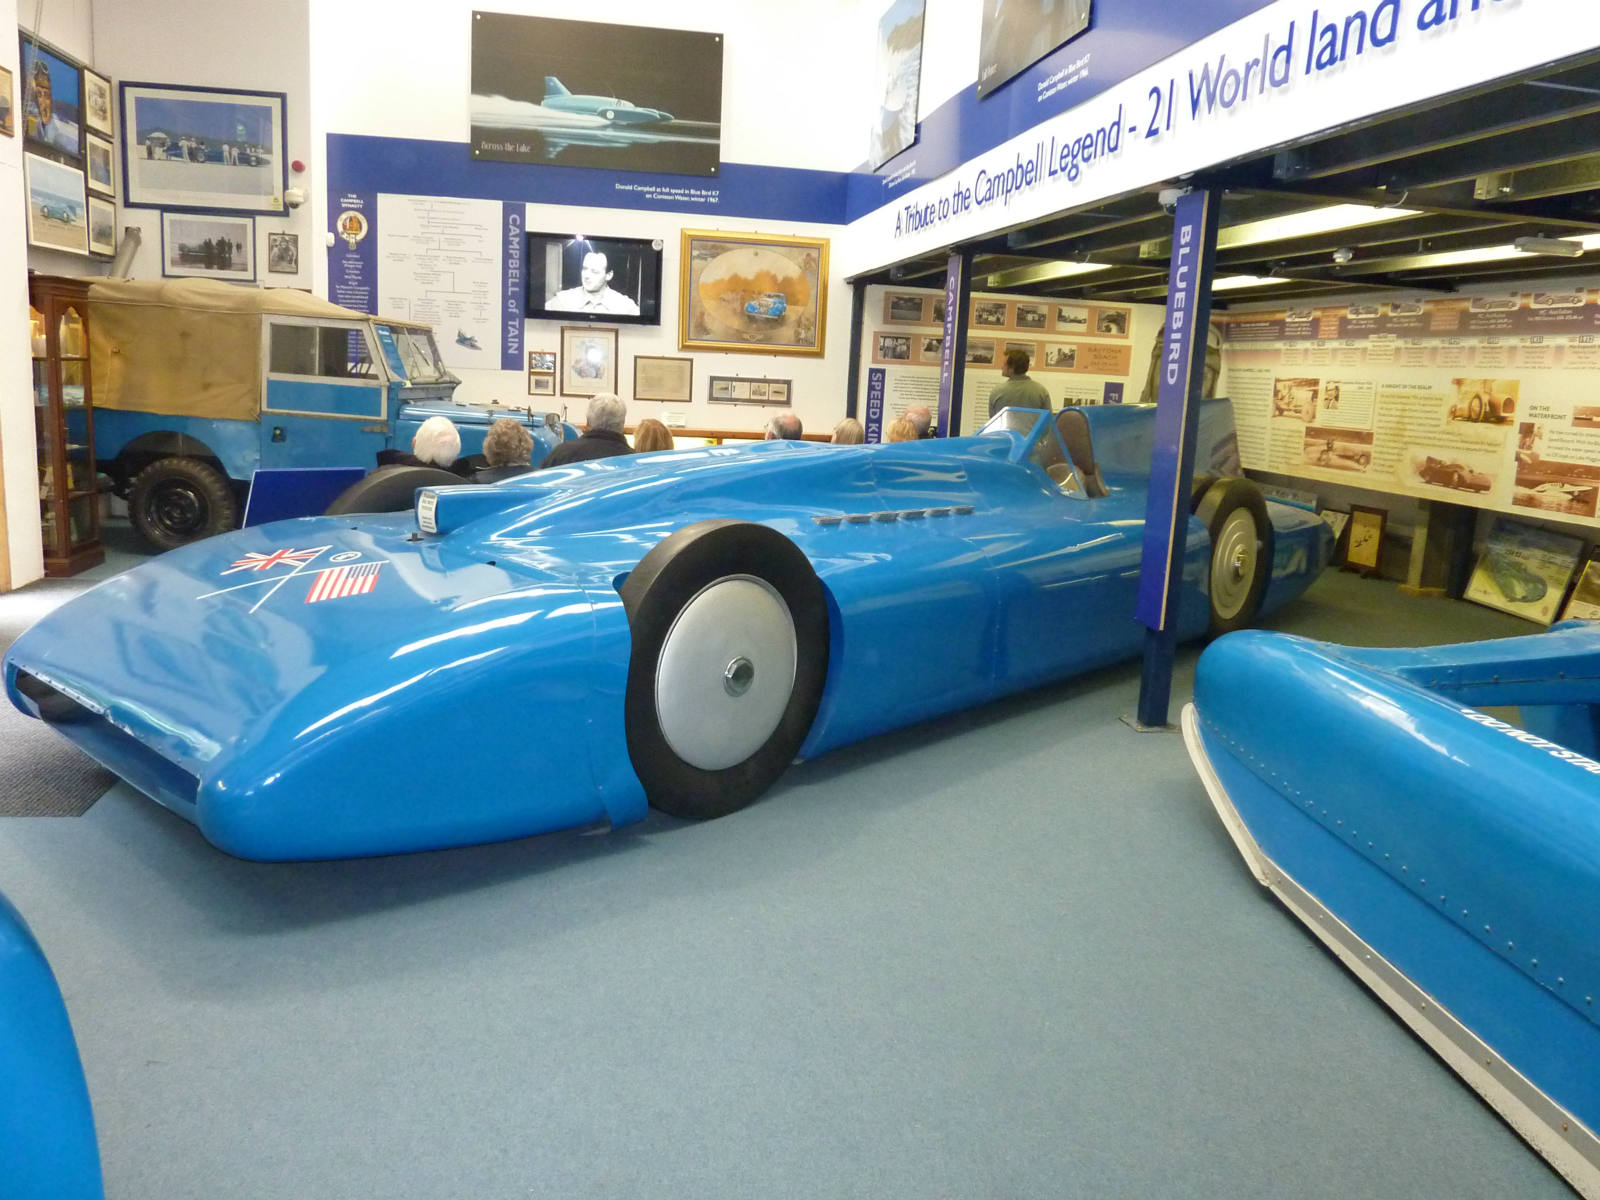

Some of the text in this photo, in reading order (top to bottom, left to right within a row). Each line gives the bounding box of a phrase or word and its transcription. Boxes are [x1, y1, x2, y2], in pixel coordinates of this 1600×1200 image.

[481, 141, 531, 153] Across the Lake
[894, 209, 902, 239] A
[904, 201, 936, 235] Tribute
[938, 195, 950, 221] to
[952, 180, 971, 215] the
[974, 141, 1044, 206] Campbell
[1047, 104, 1123, 182] Legend
[1144, 78, 1175, 139] 21
[1189, 21, 1295, 120] World
[1304, 0, 1401, 76] land
[633, 184, 656, 193] Campbell
[507, 214, 520, 355] CAMPBELL of TAIN
[942, 276, 955, 383] CAMPBELL
[1167, 224, 1192, 385] BLUEBIRD
[869, 372, 883, 419] SPEED
